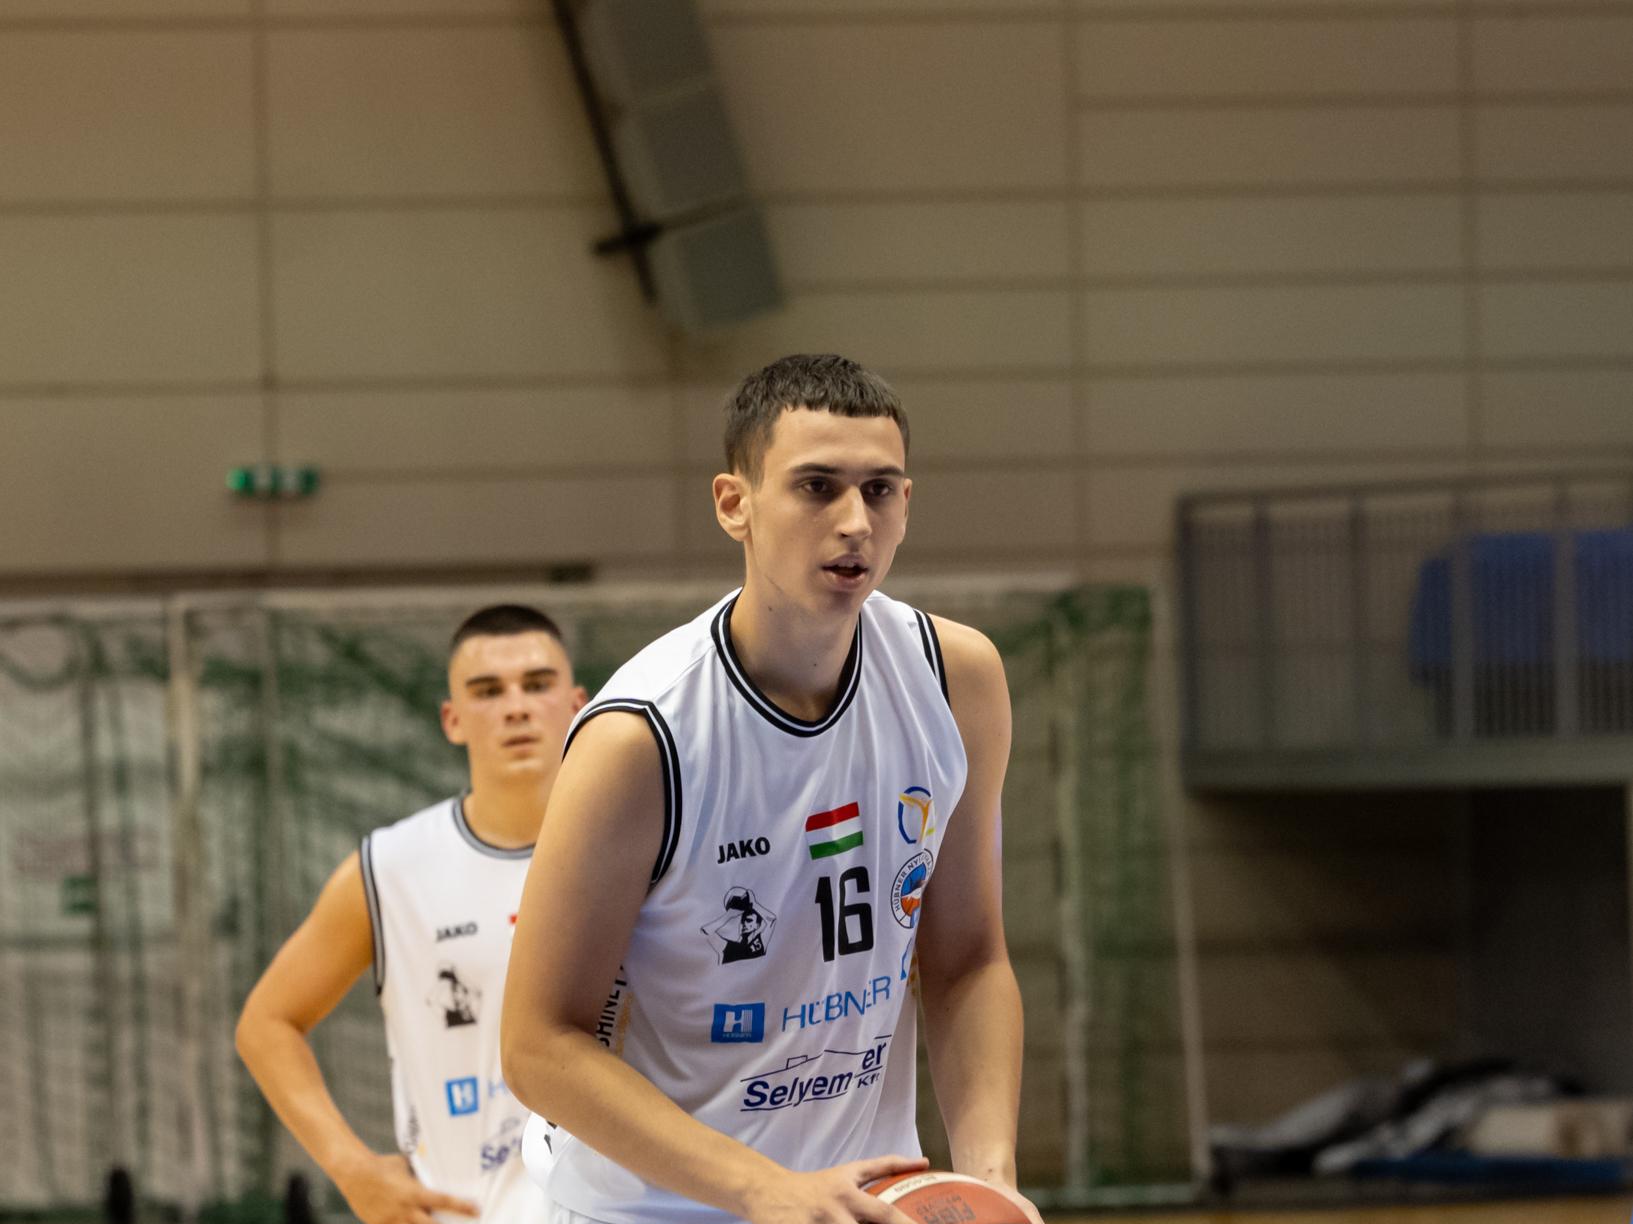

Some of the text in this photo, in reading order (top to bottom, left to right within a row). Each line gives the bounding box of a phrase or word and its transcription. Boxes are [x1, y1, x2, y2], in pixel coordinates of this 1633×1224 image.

[717, 836, 771, 864] JAKO
[815, 866, 874, 962] 16
[437, 923, 478, 942] JAKO
